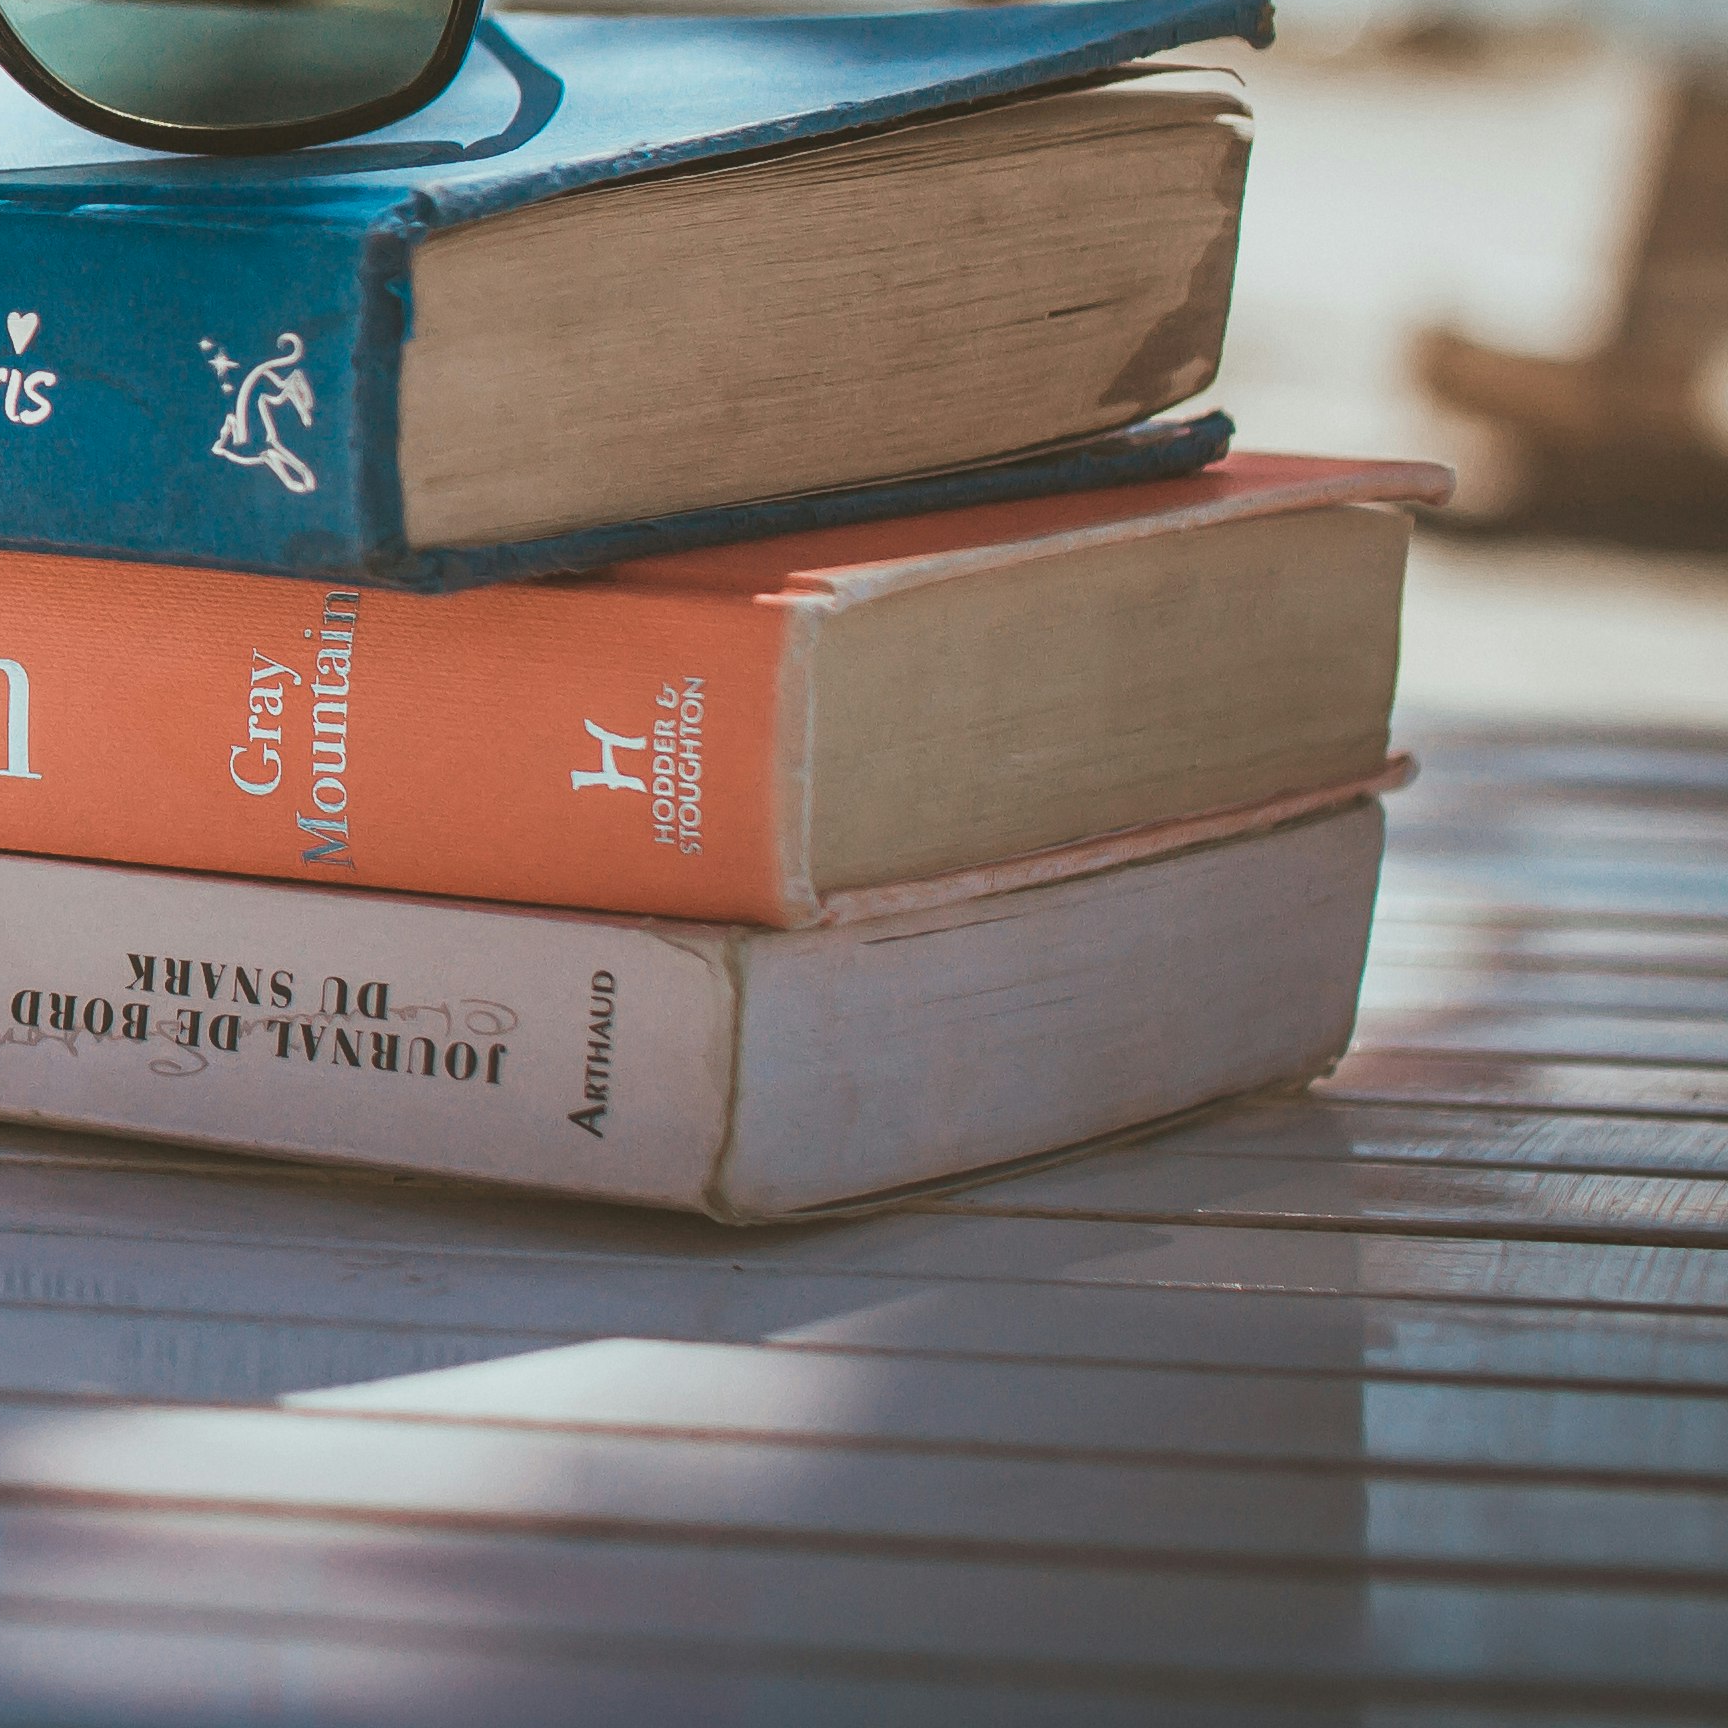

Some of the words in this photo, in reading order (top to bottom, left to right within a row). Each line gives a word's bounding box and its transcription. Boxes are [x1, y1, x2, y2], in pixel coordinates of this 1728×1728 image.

[229, 647, 302, 796] Gray
[655, 682, 679, 709] &
[294, 589, 361, 870] Mountain
[651, 718, 678, 845] HODDER
[677, 676, 705, 856] STOUGHTON
[124, 953, 295, 1010] SNARK
[316, 976, 391, 1023] DU
[8, 989, 151, 1043] BORD
[175, 1007, 241, 1055] DE
[260, 1017, 510, 1087] JOURNAL
